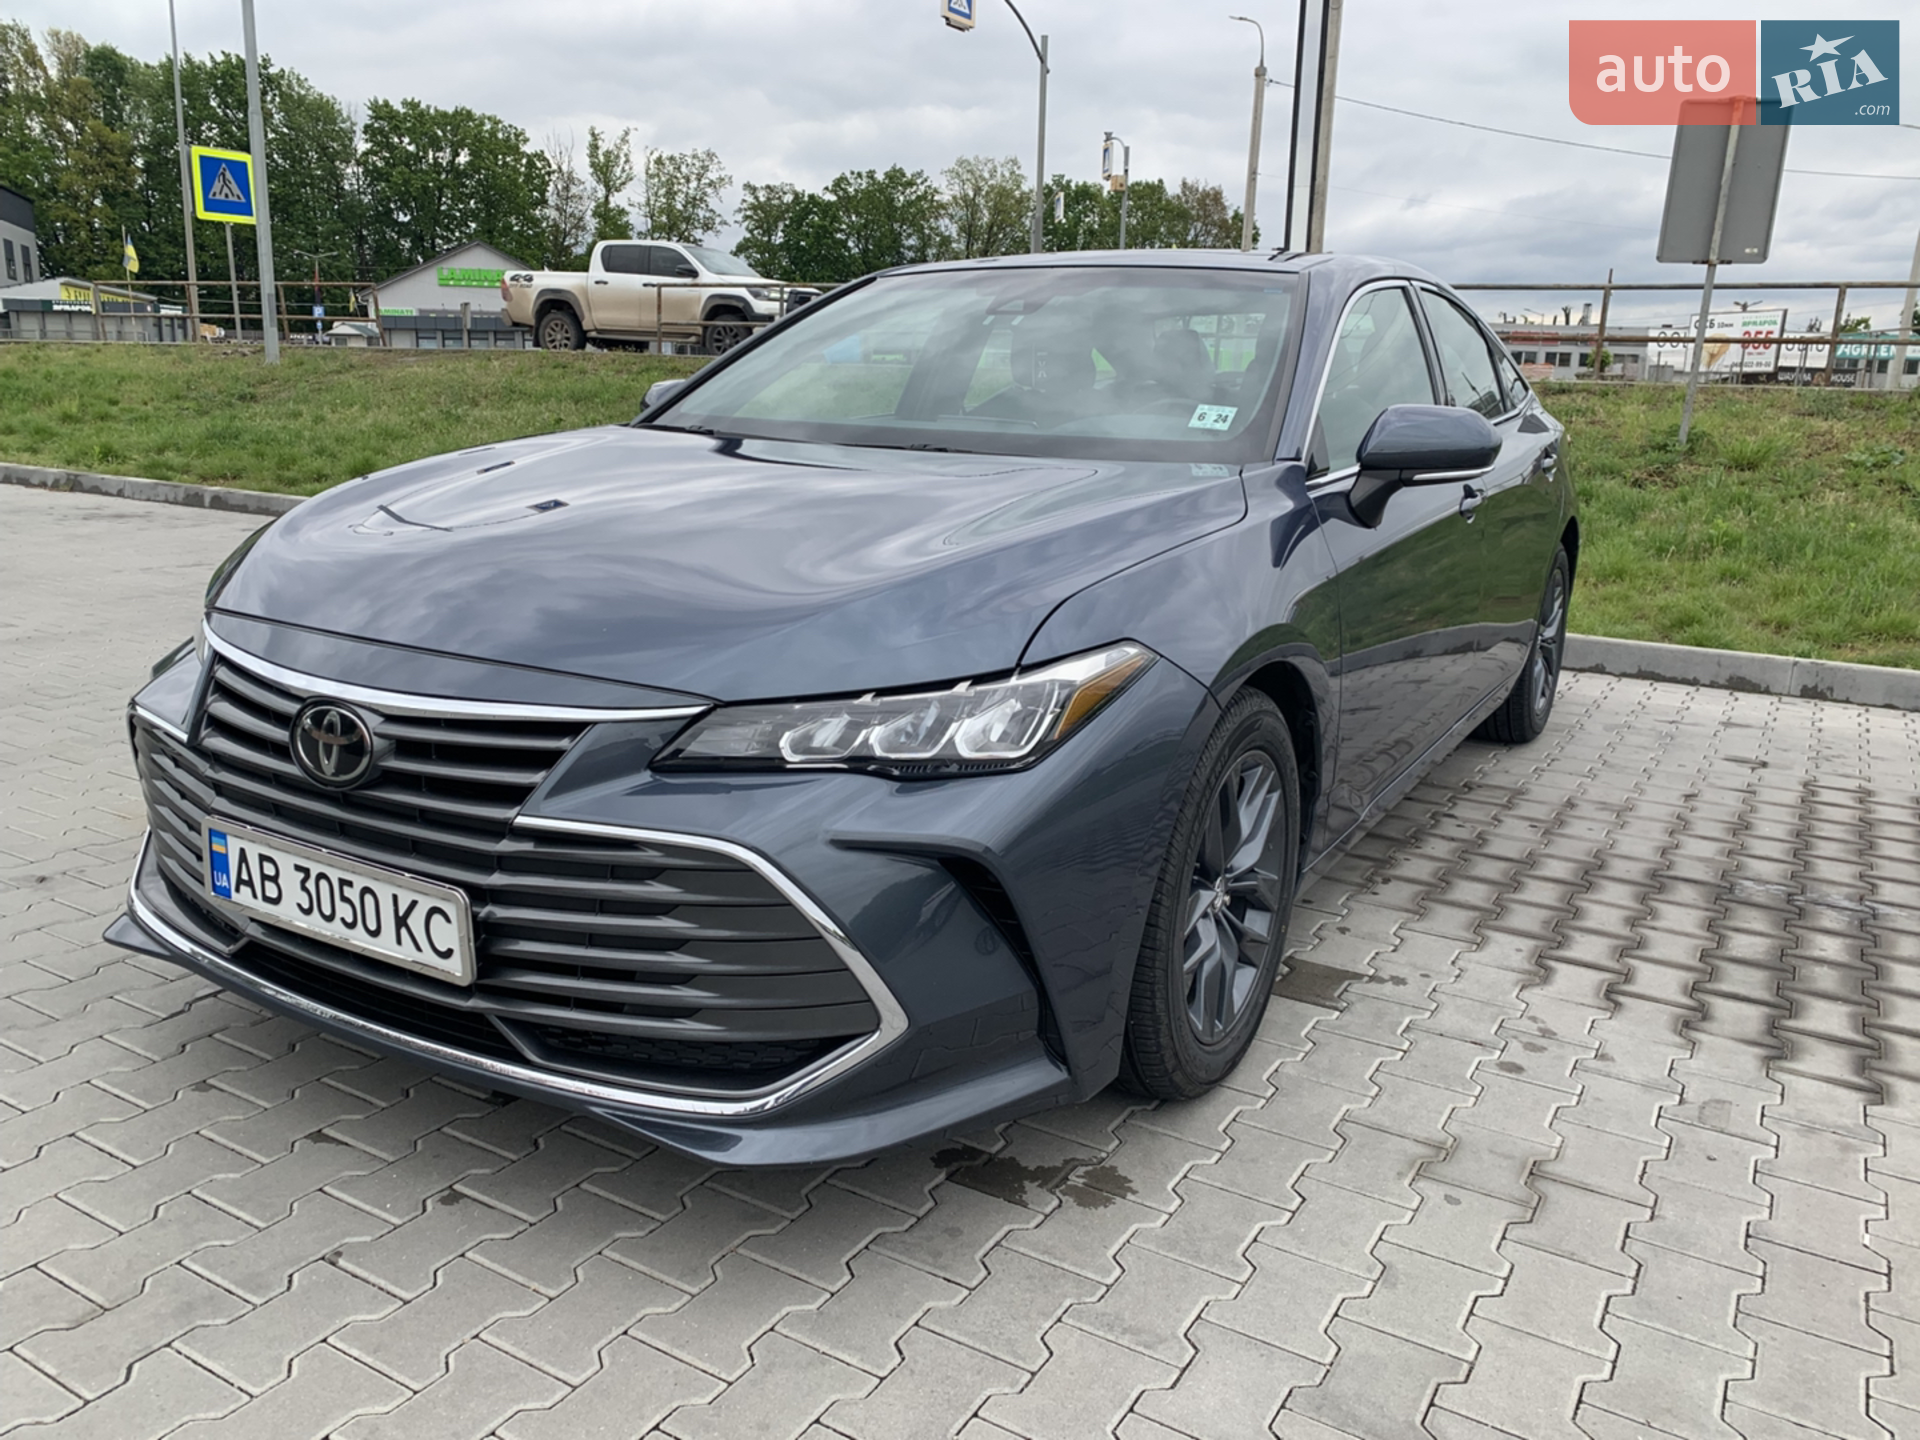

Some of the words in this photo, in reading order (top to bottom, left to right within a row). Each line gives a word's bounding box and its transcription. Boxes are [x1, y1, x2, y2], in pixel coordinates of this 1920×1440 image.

[437, 268, 505, 281] LAMINA
[1831, 373, 1856, 383] HOUSE
[1197, 411, 1208, 422] 6
[1213, 412, 1229, 424] 24
[213, 870, 230, 889] UA
[234, 847, 284, 906] AB
[293, 863, 382, 938] 3050
[391, 893, 455, 960] KC
